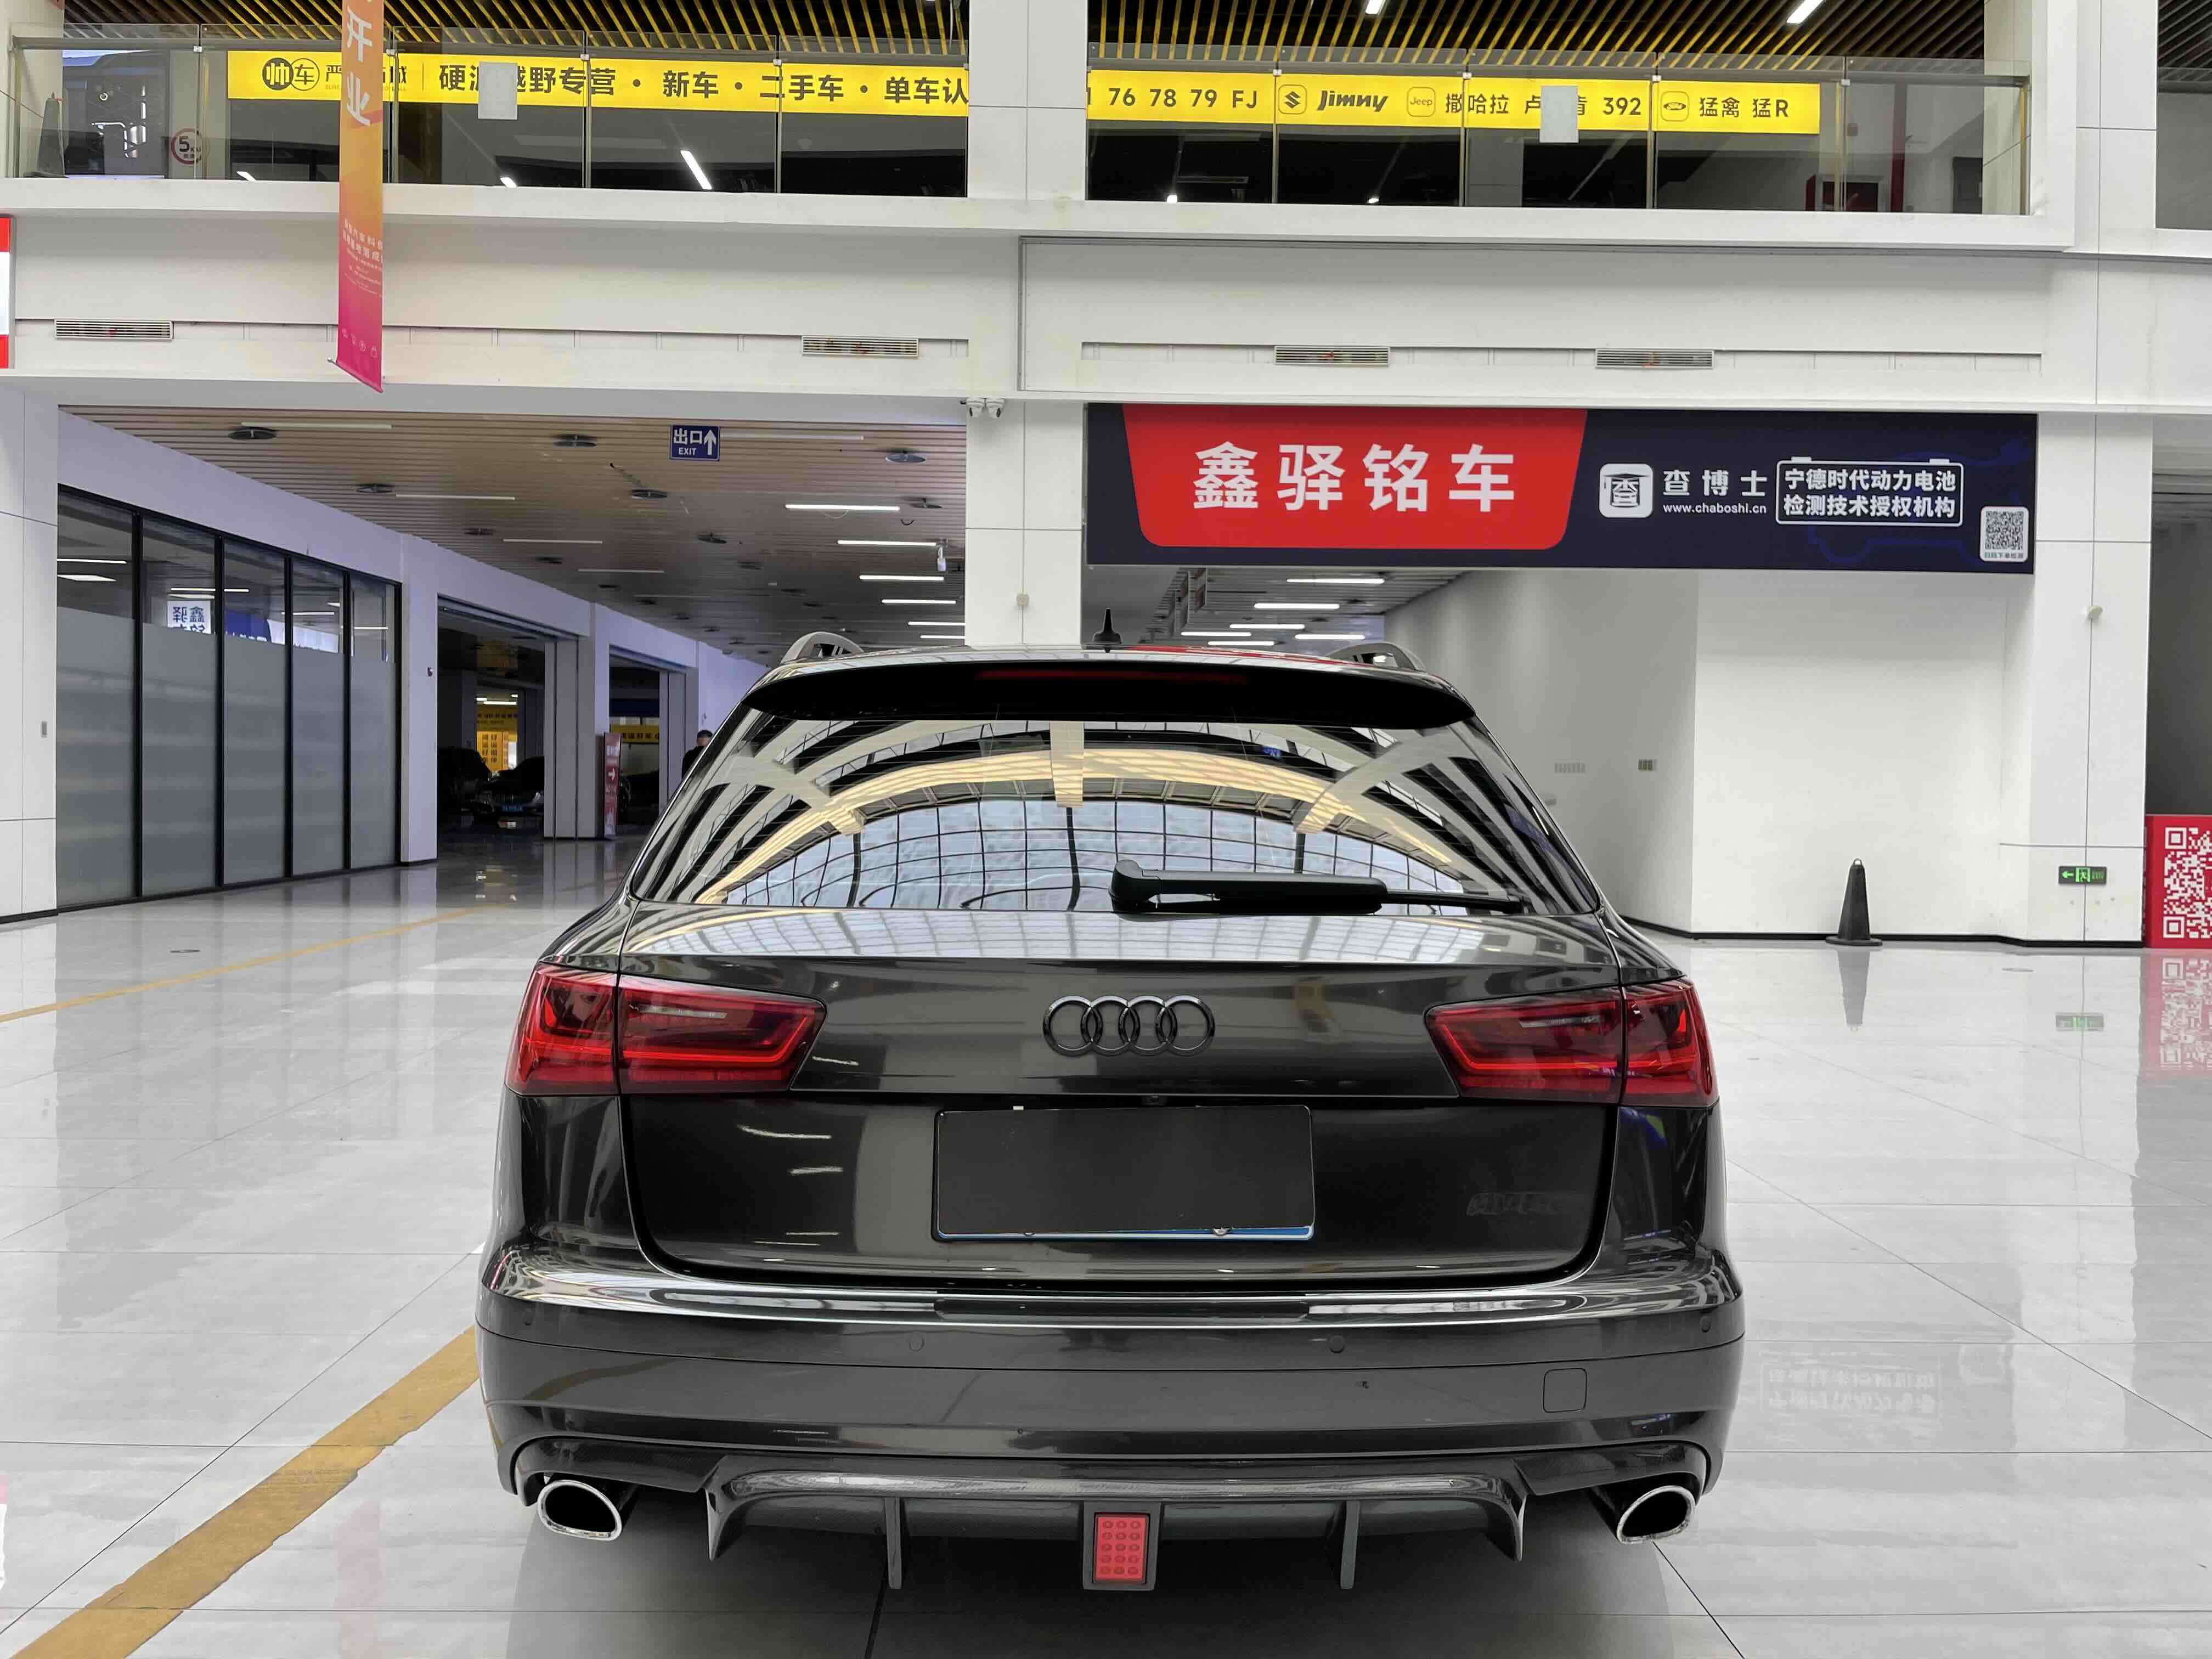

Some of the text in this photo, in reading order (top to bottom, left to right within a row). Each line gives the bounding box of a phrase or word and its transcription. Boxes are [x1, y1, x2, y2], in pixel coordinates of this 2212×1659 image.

[266, 62, 315, 86] 帅车
[347, 5, 373, 126] 开业
[439, 64, 969, 105] 硬野专营 新车 二手车 单车认
[1108, 88, 1136, 106] 76
[1149, 88, 1177, 108] 78
[1190, 89, 1217, 108] 79
[1232, 90, 1257, 109] FJ
[1316, 90, 1389, 112] Jimny
[1409, 97, 1433, 106] Jeep
[1445, 93, 1509, 114] 撒哈拉
[1602, 97, 1641, 116] 392
[1699, 97, 1789, 118] 猛禽 猛R
[673, 428, 703, 445] 出口
[678, 447, 697, 456] EXIT
[1193, 441, 1515, 512] 鑫驿铭车
[1662, 469, 1768, 496] 查博士
[1784, 468, 1956, 493] 宁德时代动力电池
[1783, 494, 1956, 519] 检测技术授权机构
